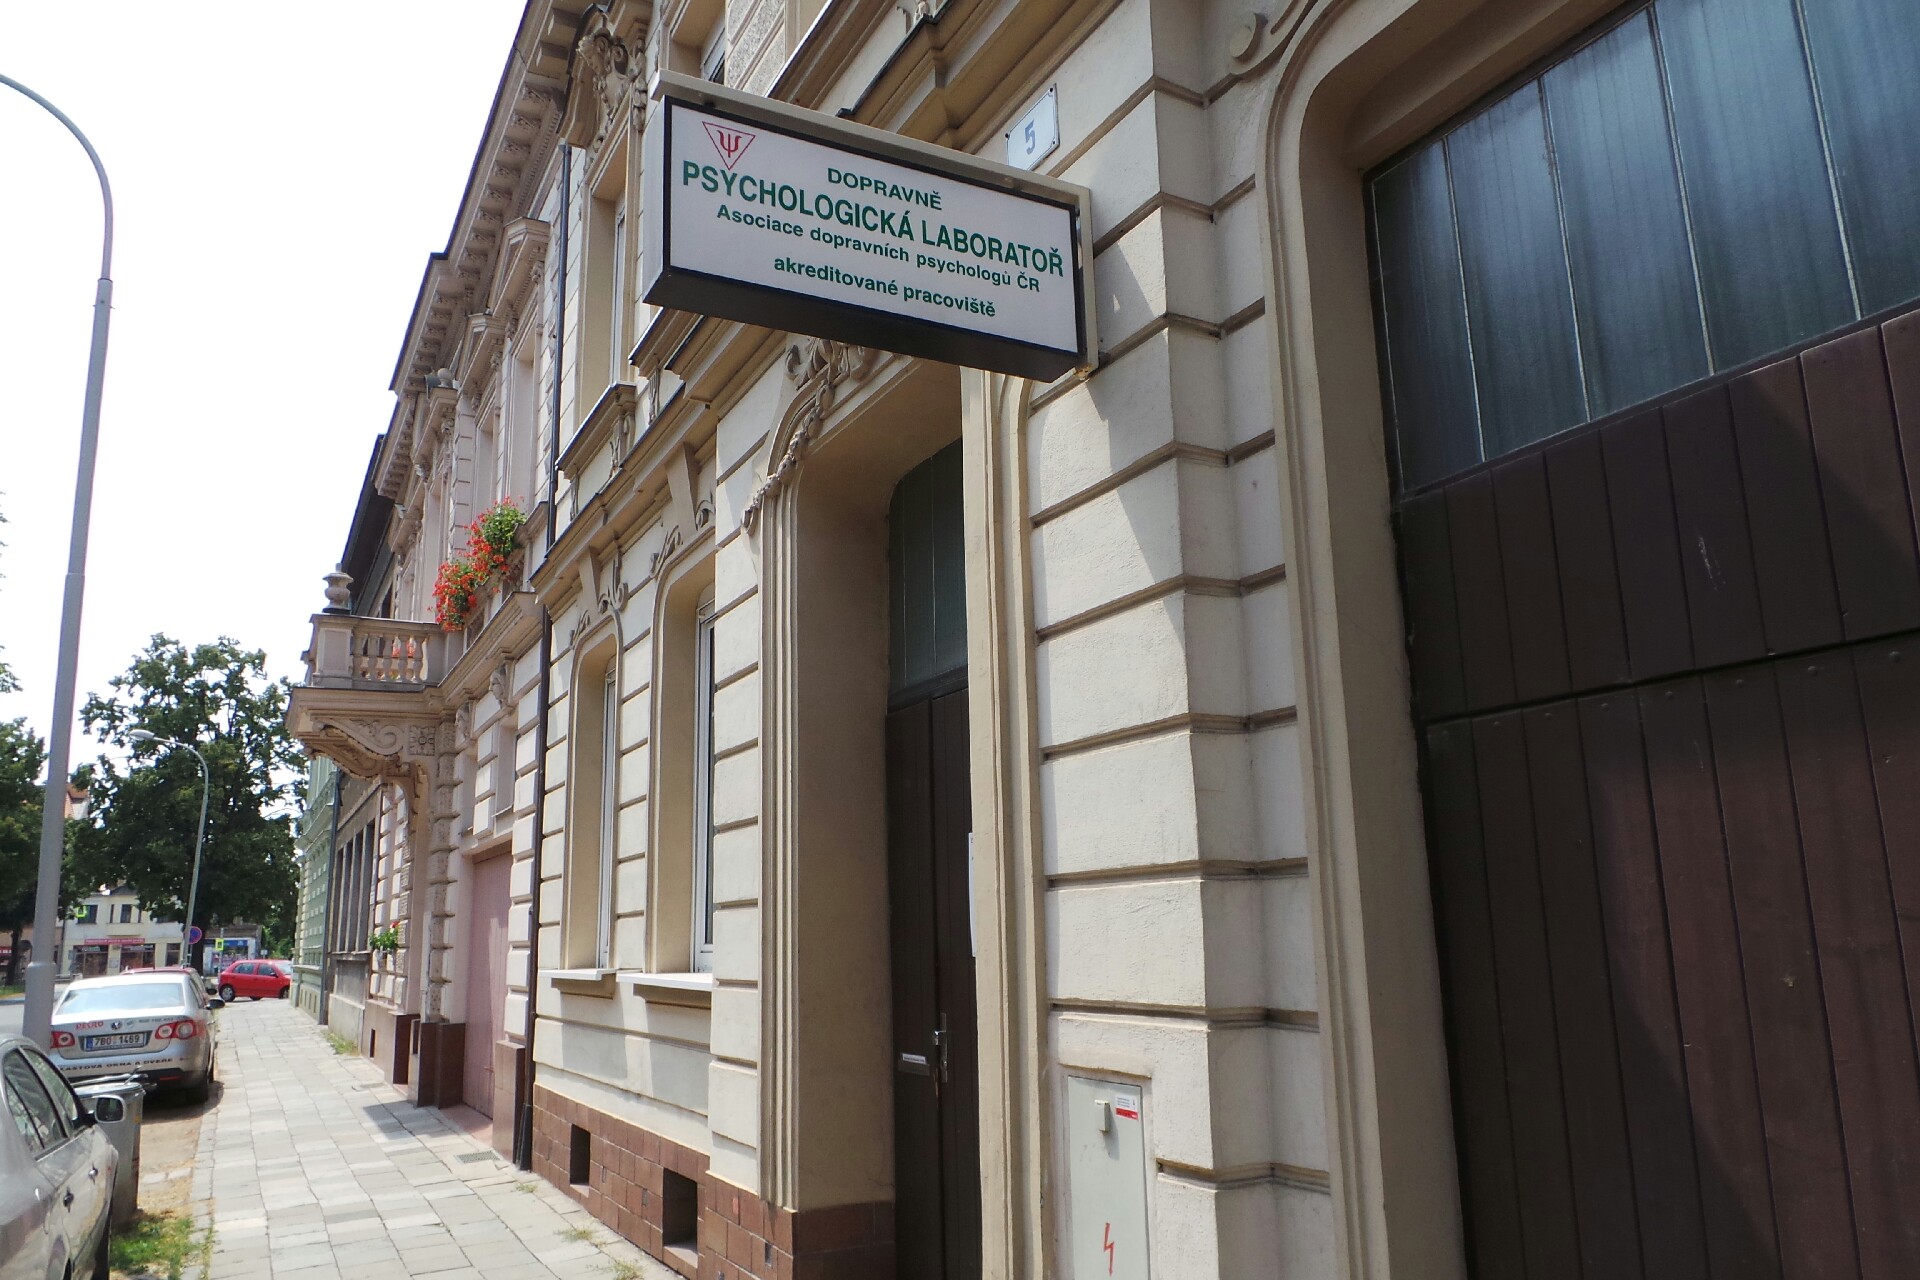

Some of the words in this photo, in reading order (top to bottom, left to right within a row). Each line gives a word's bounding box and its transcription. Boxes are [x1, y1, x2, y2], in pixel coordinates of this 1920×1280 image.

[1024, 119, 1036, 155] 5
[683, 160, 914, 241] PSYCHOLOGICKÁ
[922, 220, 1064, 277] LABORATOŘ
[827, 168, 942, 211] DOPRAVNĚ
[717, 204, 804, 237] Asociace
[810, 227, 909, 262] dopravních
[916, 253, 1011, 286] psychologů
[1017, 271, 1040, 292] ČR
[774, 257, 898, 296] akreditované
[904, 285, 996, 317] pracoviště
